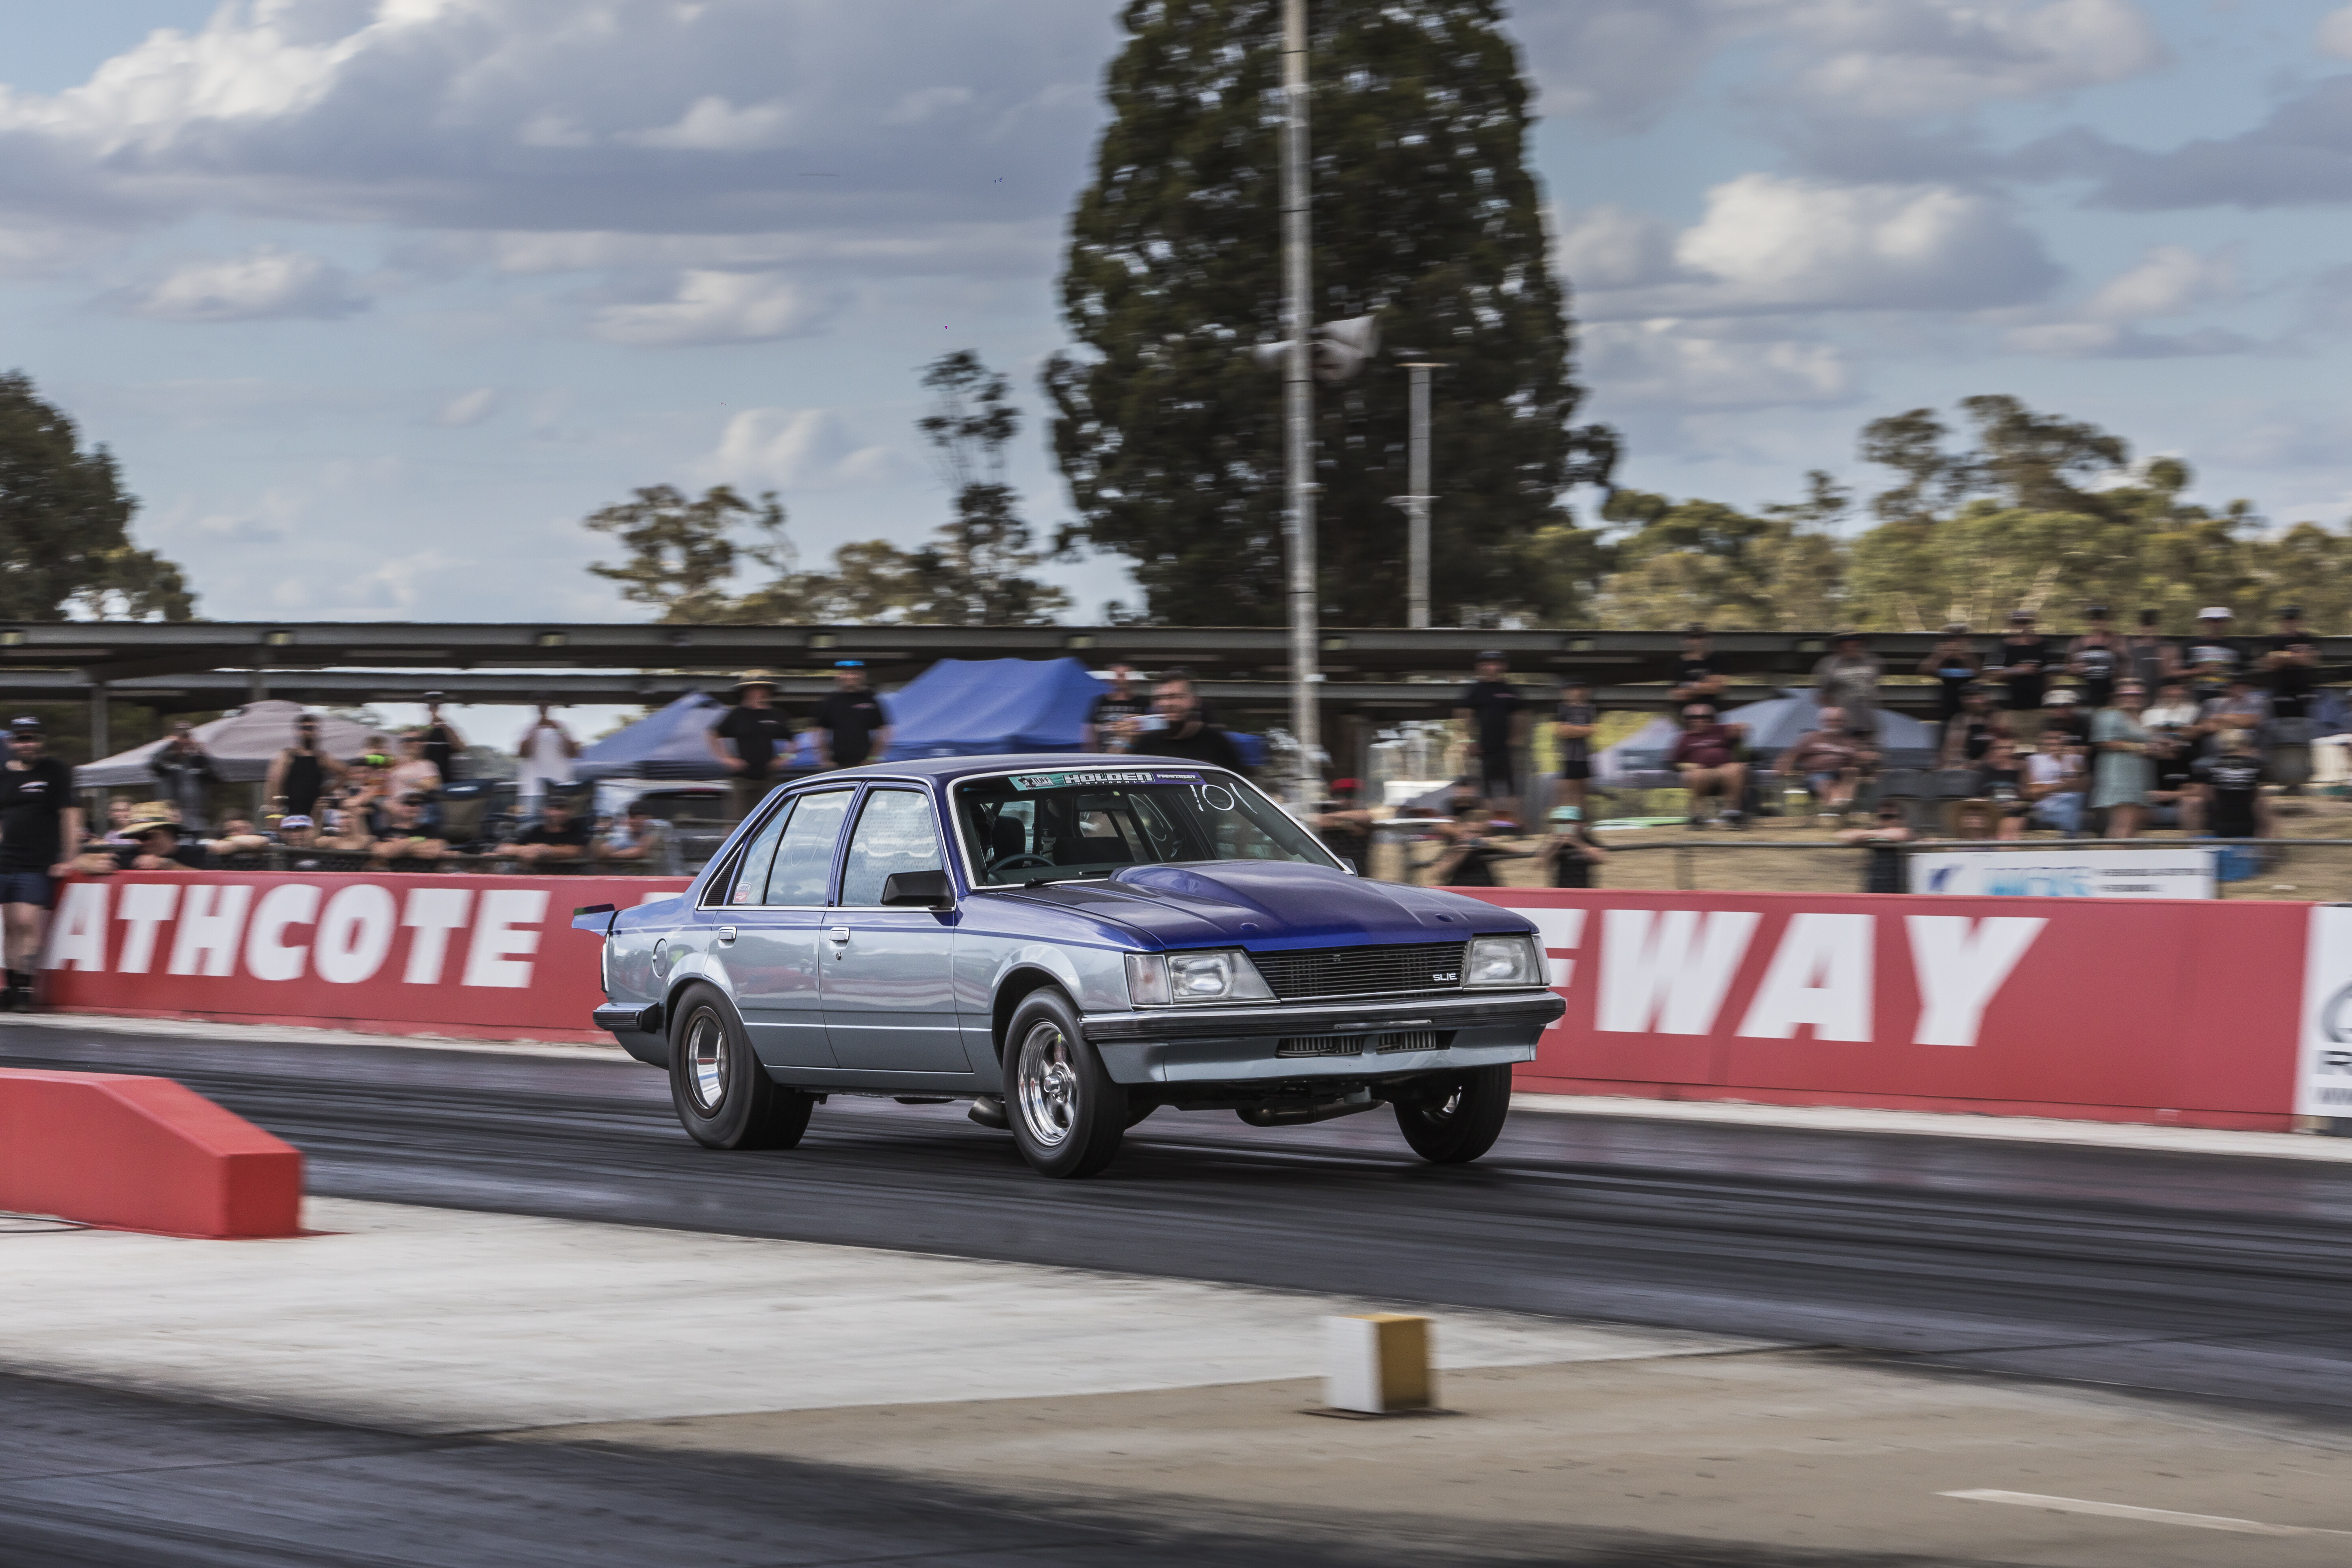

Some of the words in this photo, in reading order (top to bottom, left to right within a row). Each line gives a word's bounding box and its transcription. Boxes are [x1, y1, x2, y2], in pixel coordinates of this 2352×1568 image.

[1063, 772, 1153, 784] HOLDEN
[1189, 783, 1258, 814] 101
[1, 883, 552, 988] ATHCOTE
